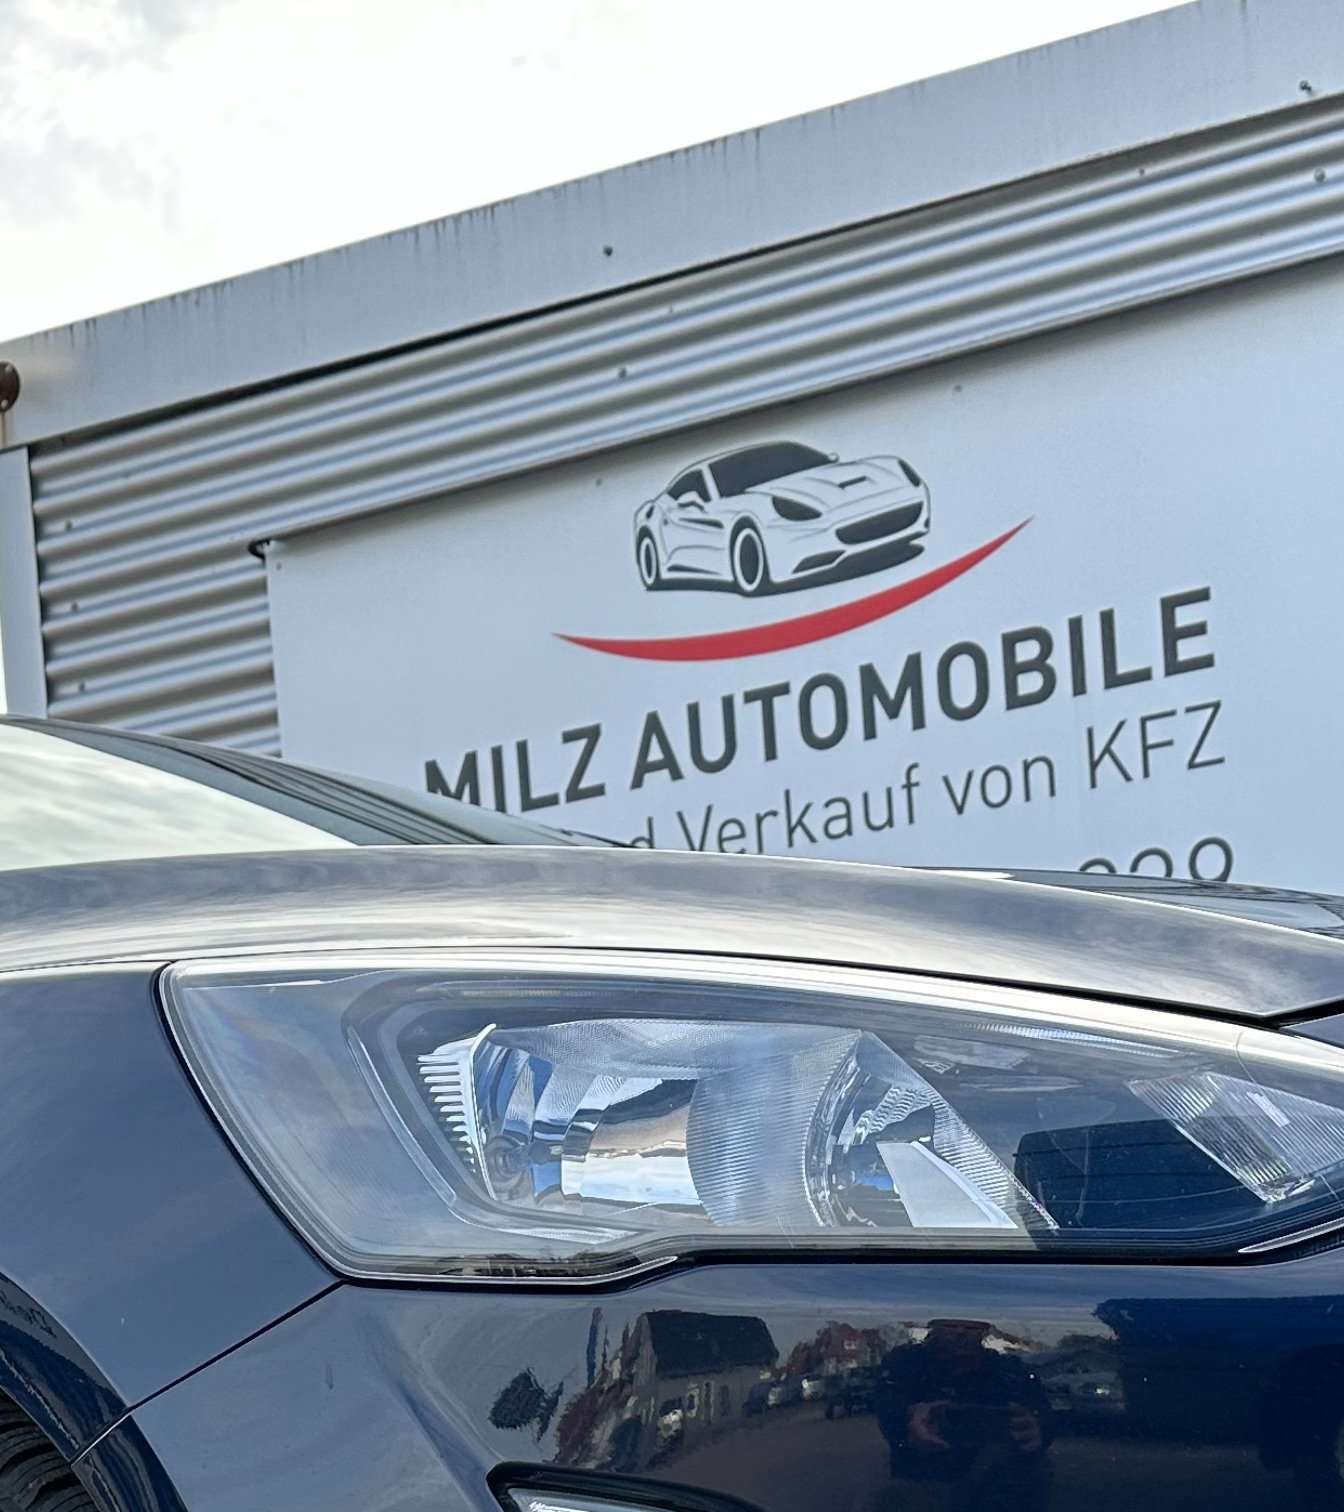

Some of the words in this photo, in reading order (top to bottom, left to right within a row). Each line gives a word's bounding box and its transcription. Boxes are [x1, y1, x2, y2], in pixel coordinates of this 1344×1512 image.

[425, 722, 607, 814] MILZ
[629, 586, 1216, 791] AUTOMOBILE
[676, 761, 921, 855] Verkauf
[940, 751, 1058, 818] von
[1083, 699, 1227, 792] KFZ
